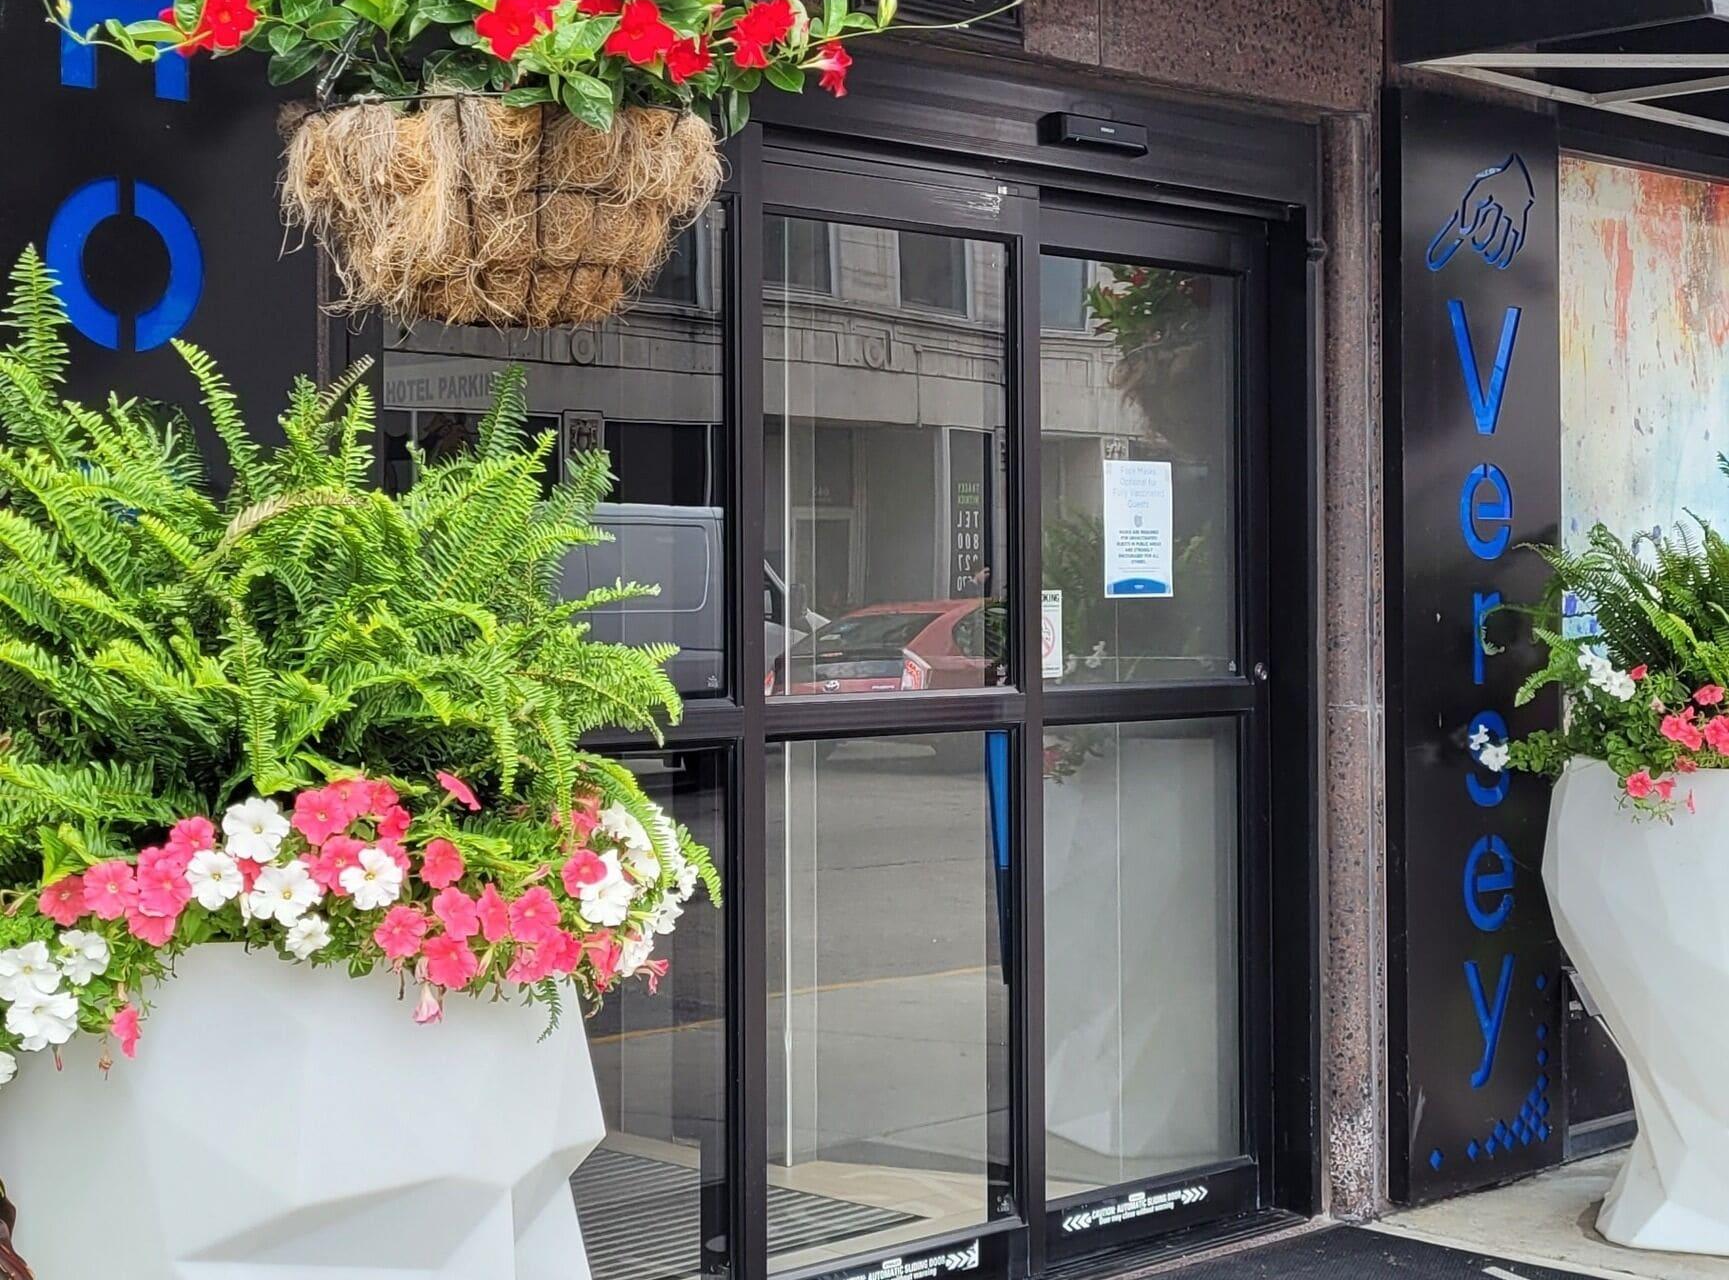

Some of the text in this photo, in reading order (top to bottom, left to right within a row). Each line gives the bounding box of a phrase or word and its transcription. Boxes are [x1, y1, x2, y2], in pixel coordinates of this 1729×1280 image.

[386, 373, 498, 403] HOTEL PARKIN
[1446, 298, 1522, 1089] Versey
[904, 1259, 928, 1274] SLIDING
